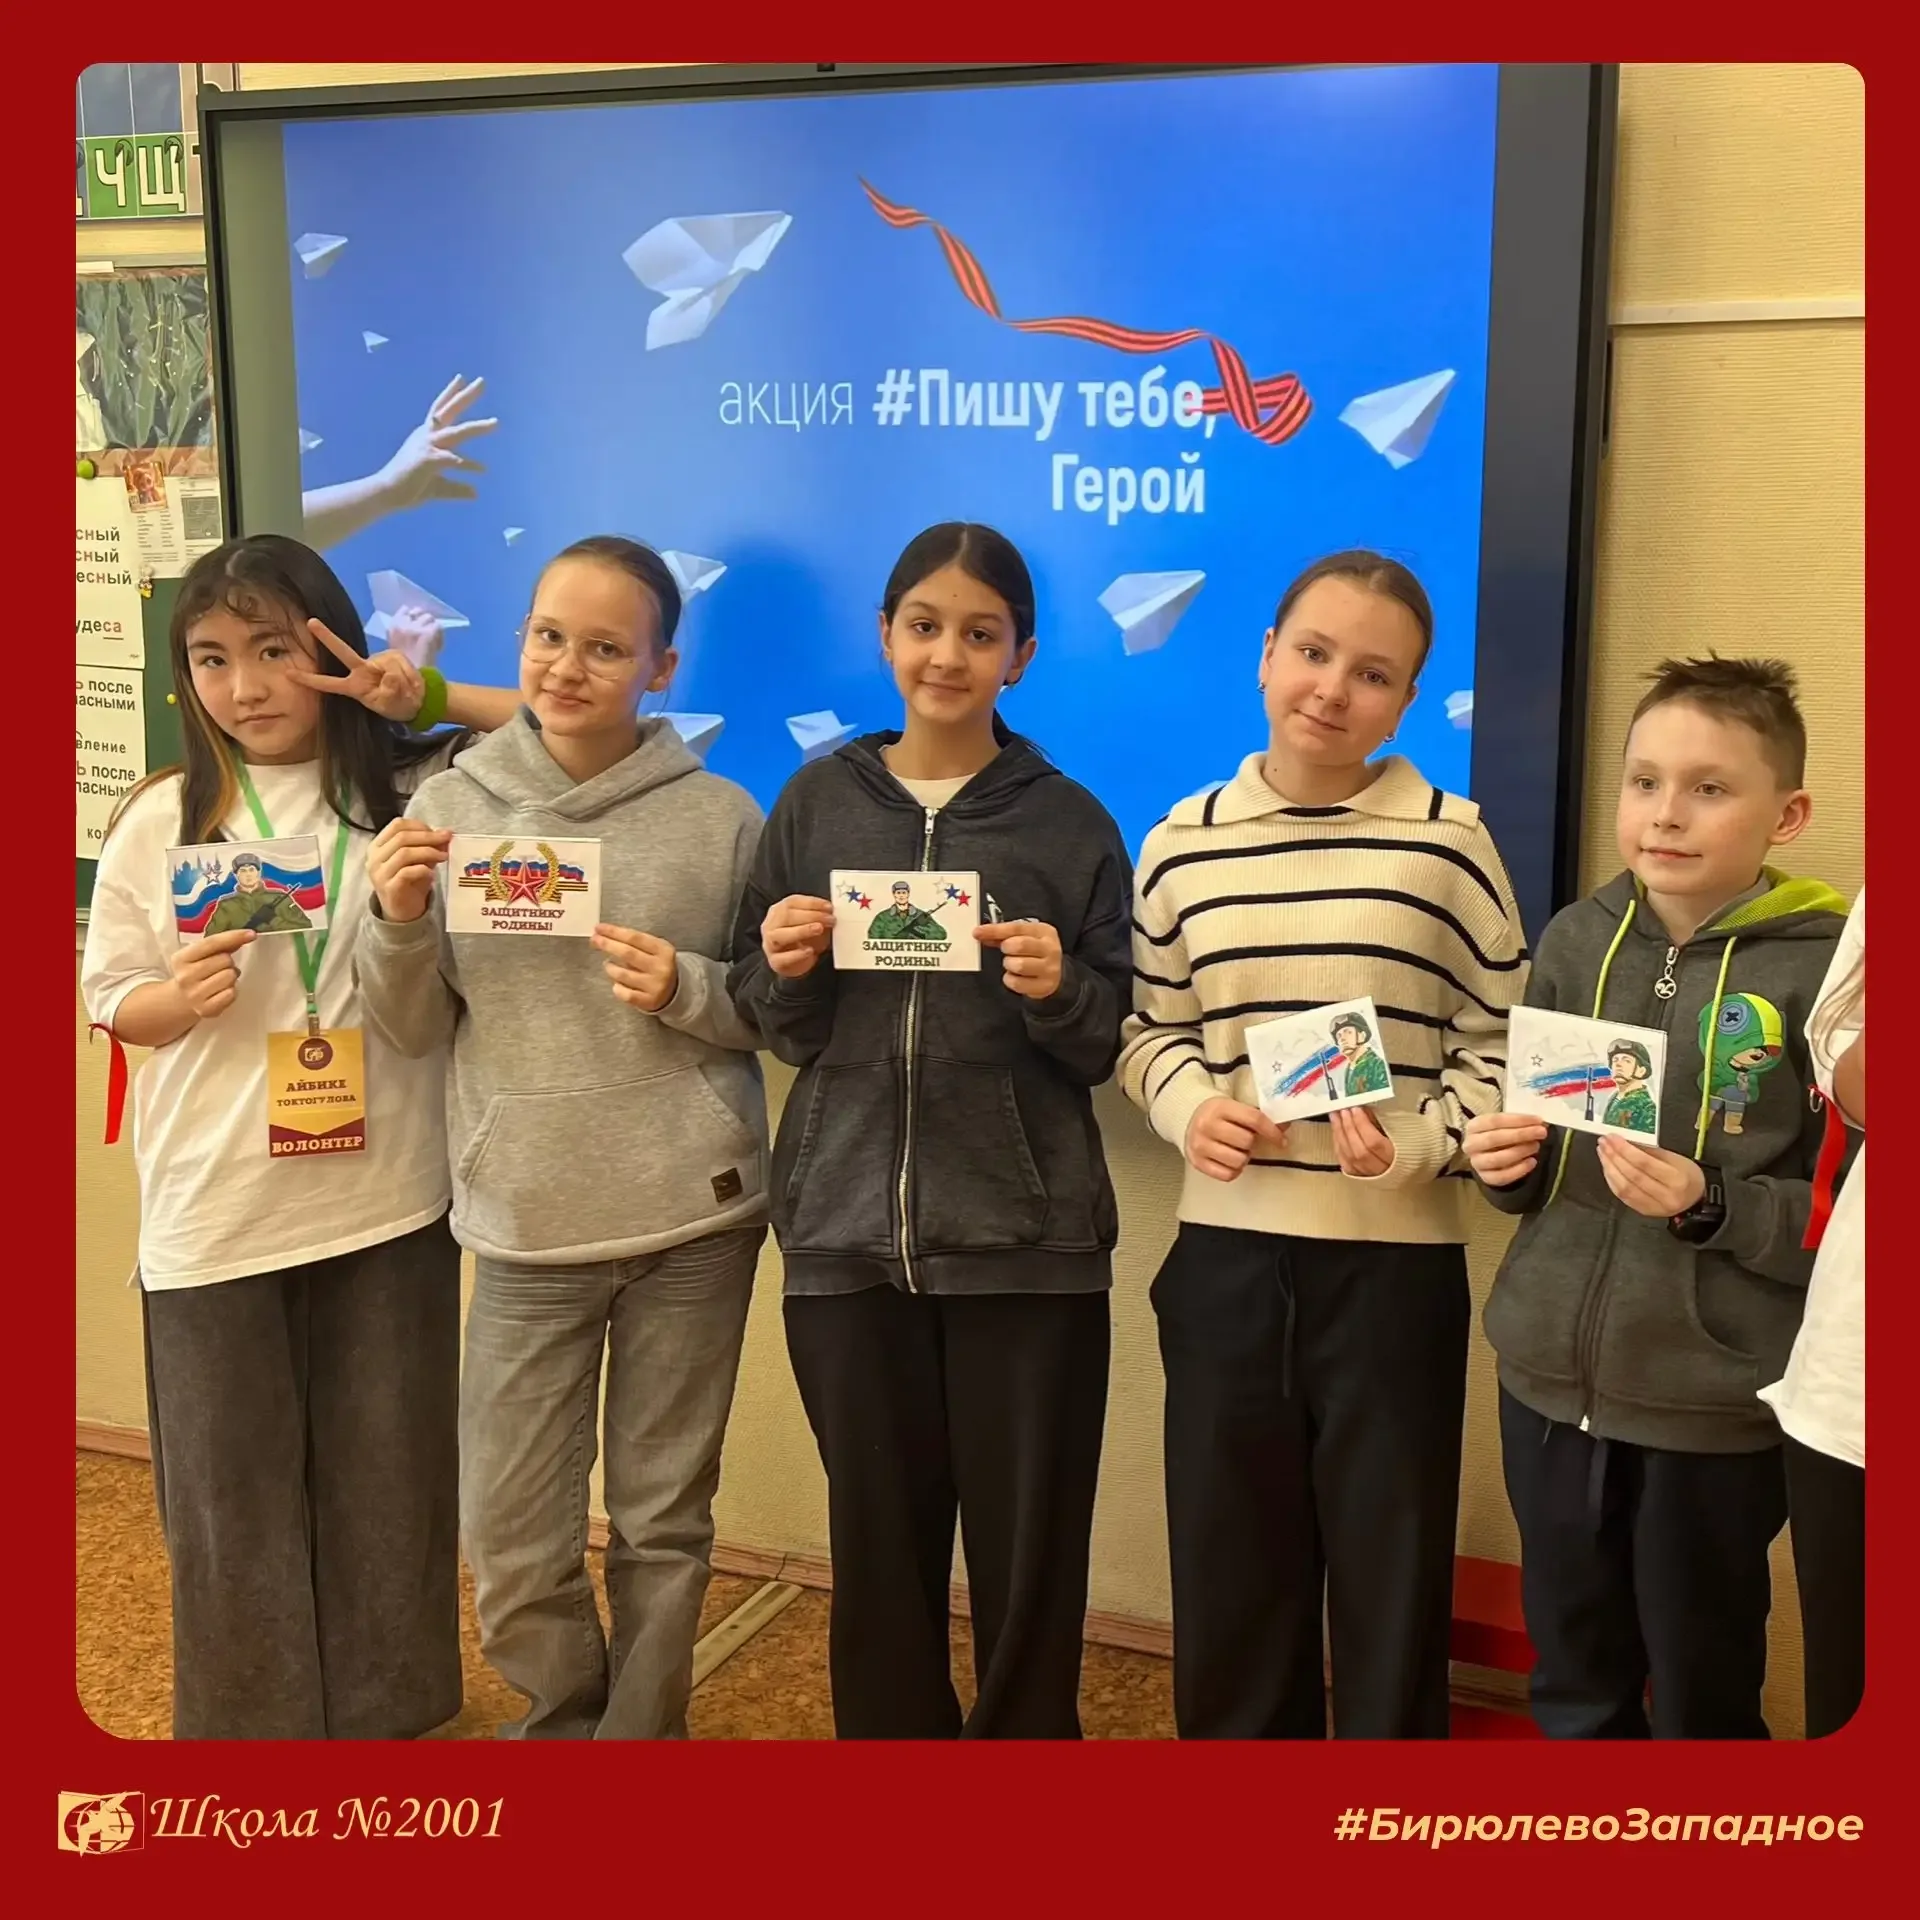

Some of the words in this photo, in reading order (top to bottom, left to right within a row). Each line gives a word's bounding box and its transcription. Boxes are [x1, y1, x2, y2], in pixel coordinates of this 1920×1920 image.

[95, 148, 126, 207] Ч
[138, 145, 185, 212] Щ
[719, 380, 853, 432] акция
[873, 368, 1064, 441] #Пишу
[1077, 365, 1218, 437] тебе,
[1052, 451, 1205, 526] Герой
[76, 570, 132, 585] есный
[88, 680, 133, 695] после
[76, 695, 136, 711] асными
[91, 765, 136, 781] после
[481, 907, 565, 919] ЗАЩИТНИКУ
[492, 920, 553, 931] РОДИНЫ!
[862, 941, 952, 953] ЗАЩИТНИКУ
[875, 956, 940, 967] РОДИНЫ!
[286, 1079, 347, 1092] АЙБИКЕ
[277, 1094, 356, 1107] ТОКТОГУЛОВА
[272, 1136, 364, 1154] ВОЛОНТЕР
